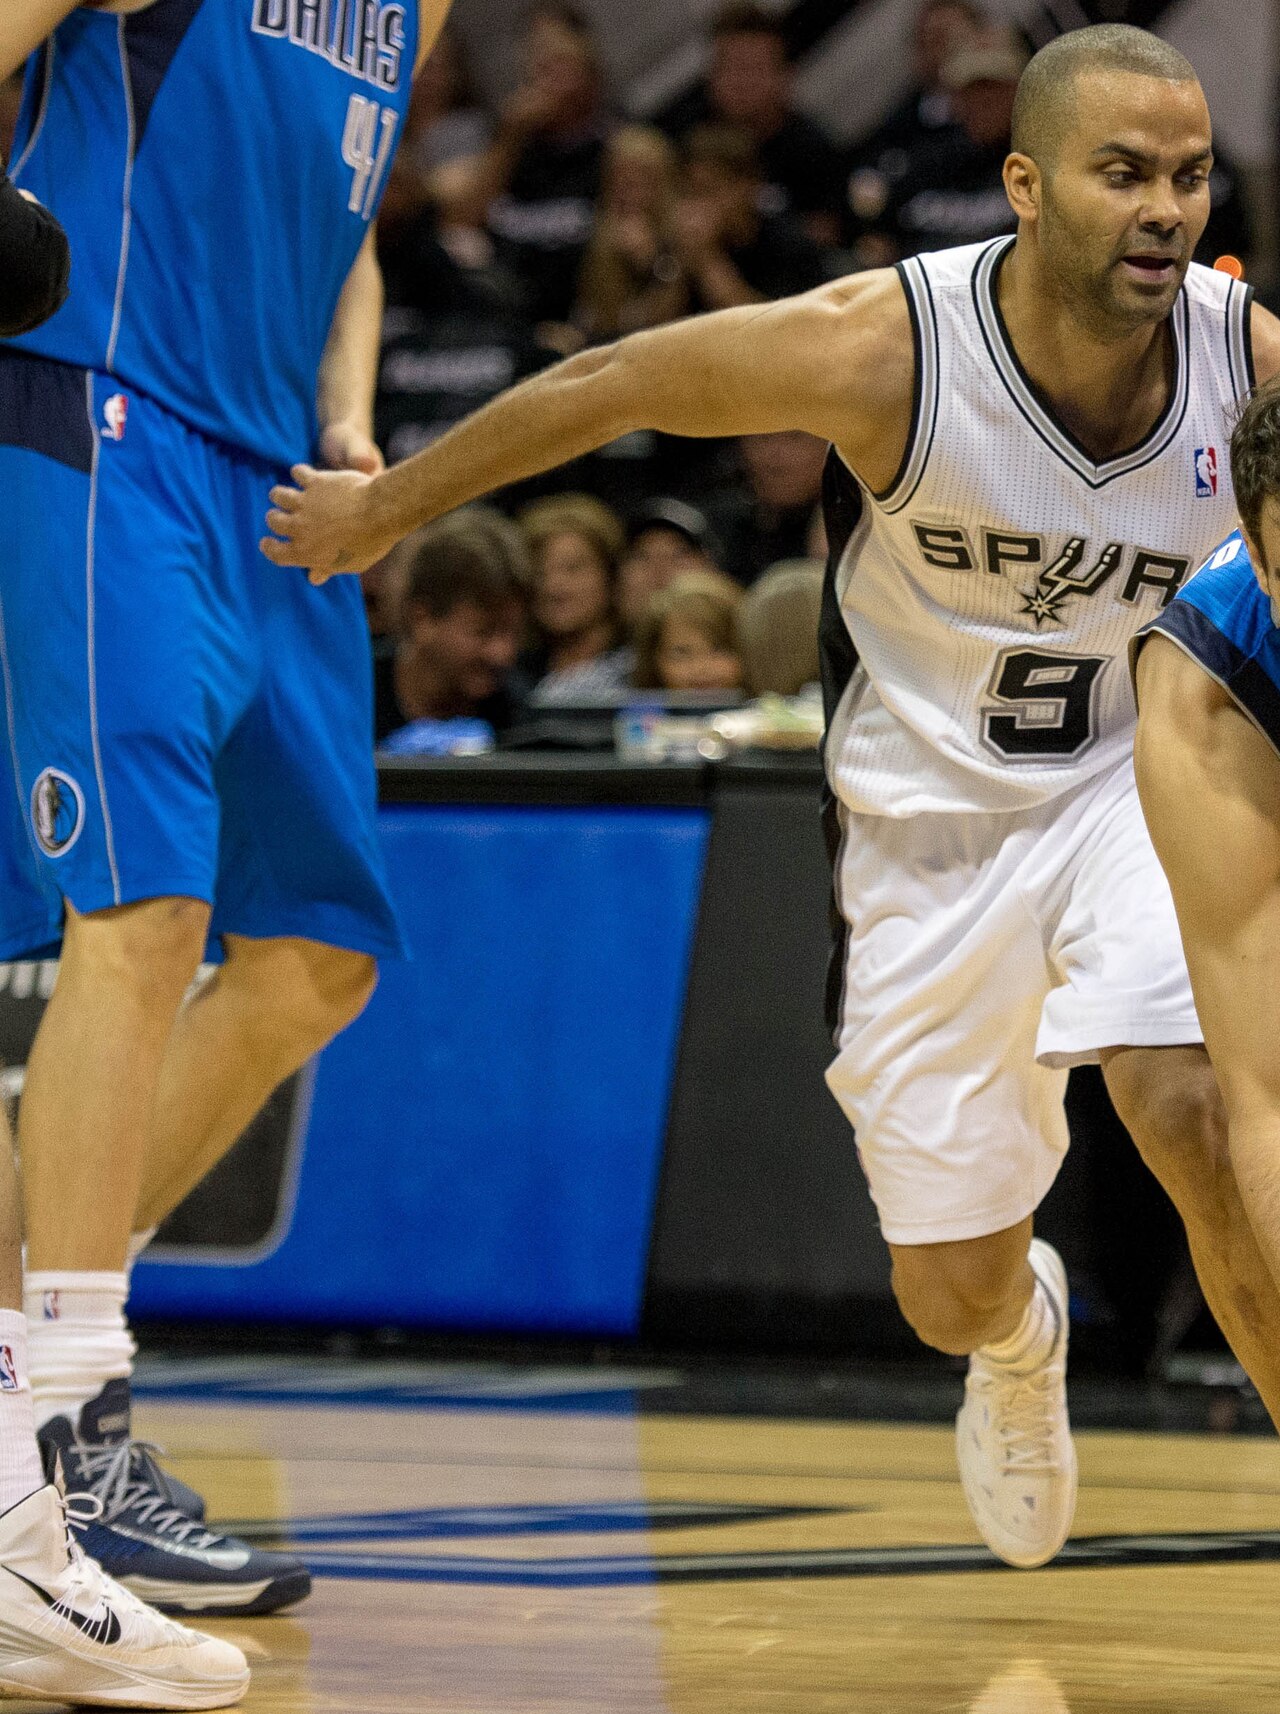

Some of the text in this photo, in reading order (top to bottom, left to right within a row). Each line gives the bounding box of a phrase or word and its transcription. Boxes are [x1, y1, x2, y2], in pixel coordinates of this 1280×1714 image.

[341, 92, 400, 220] 41
[909, 519, 1195, 630] SPUR
[978, 644, 1115, 764] 9
